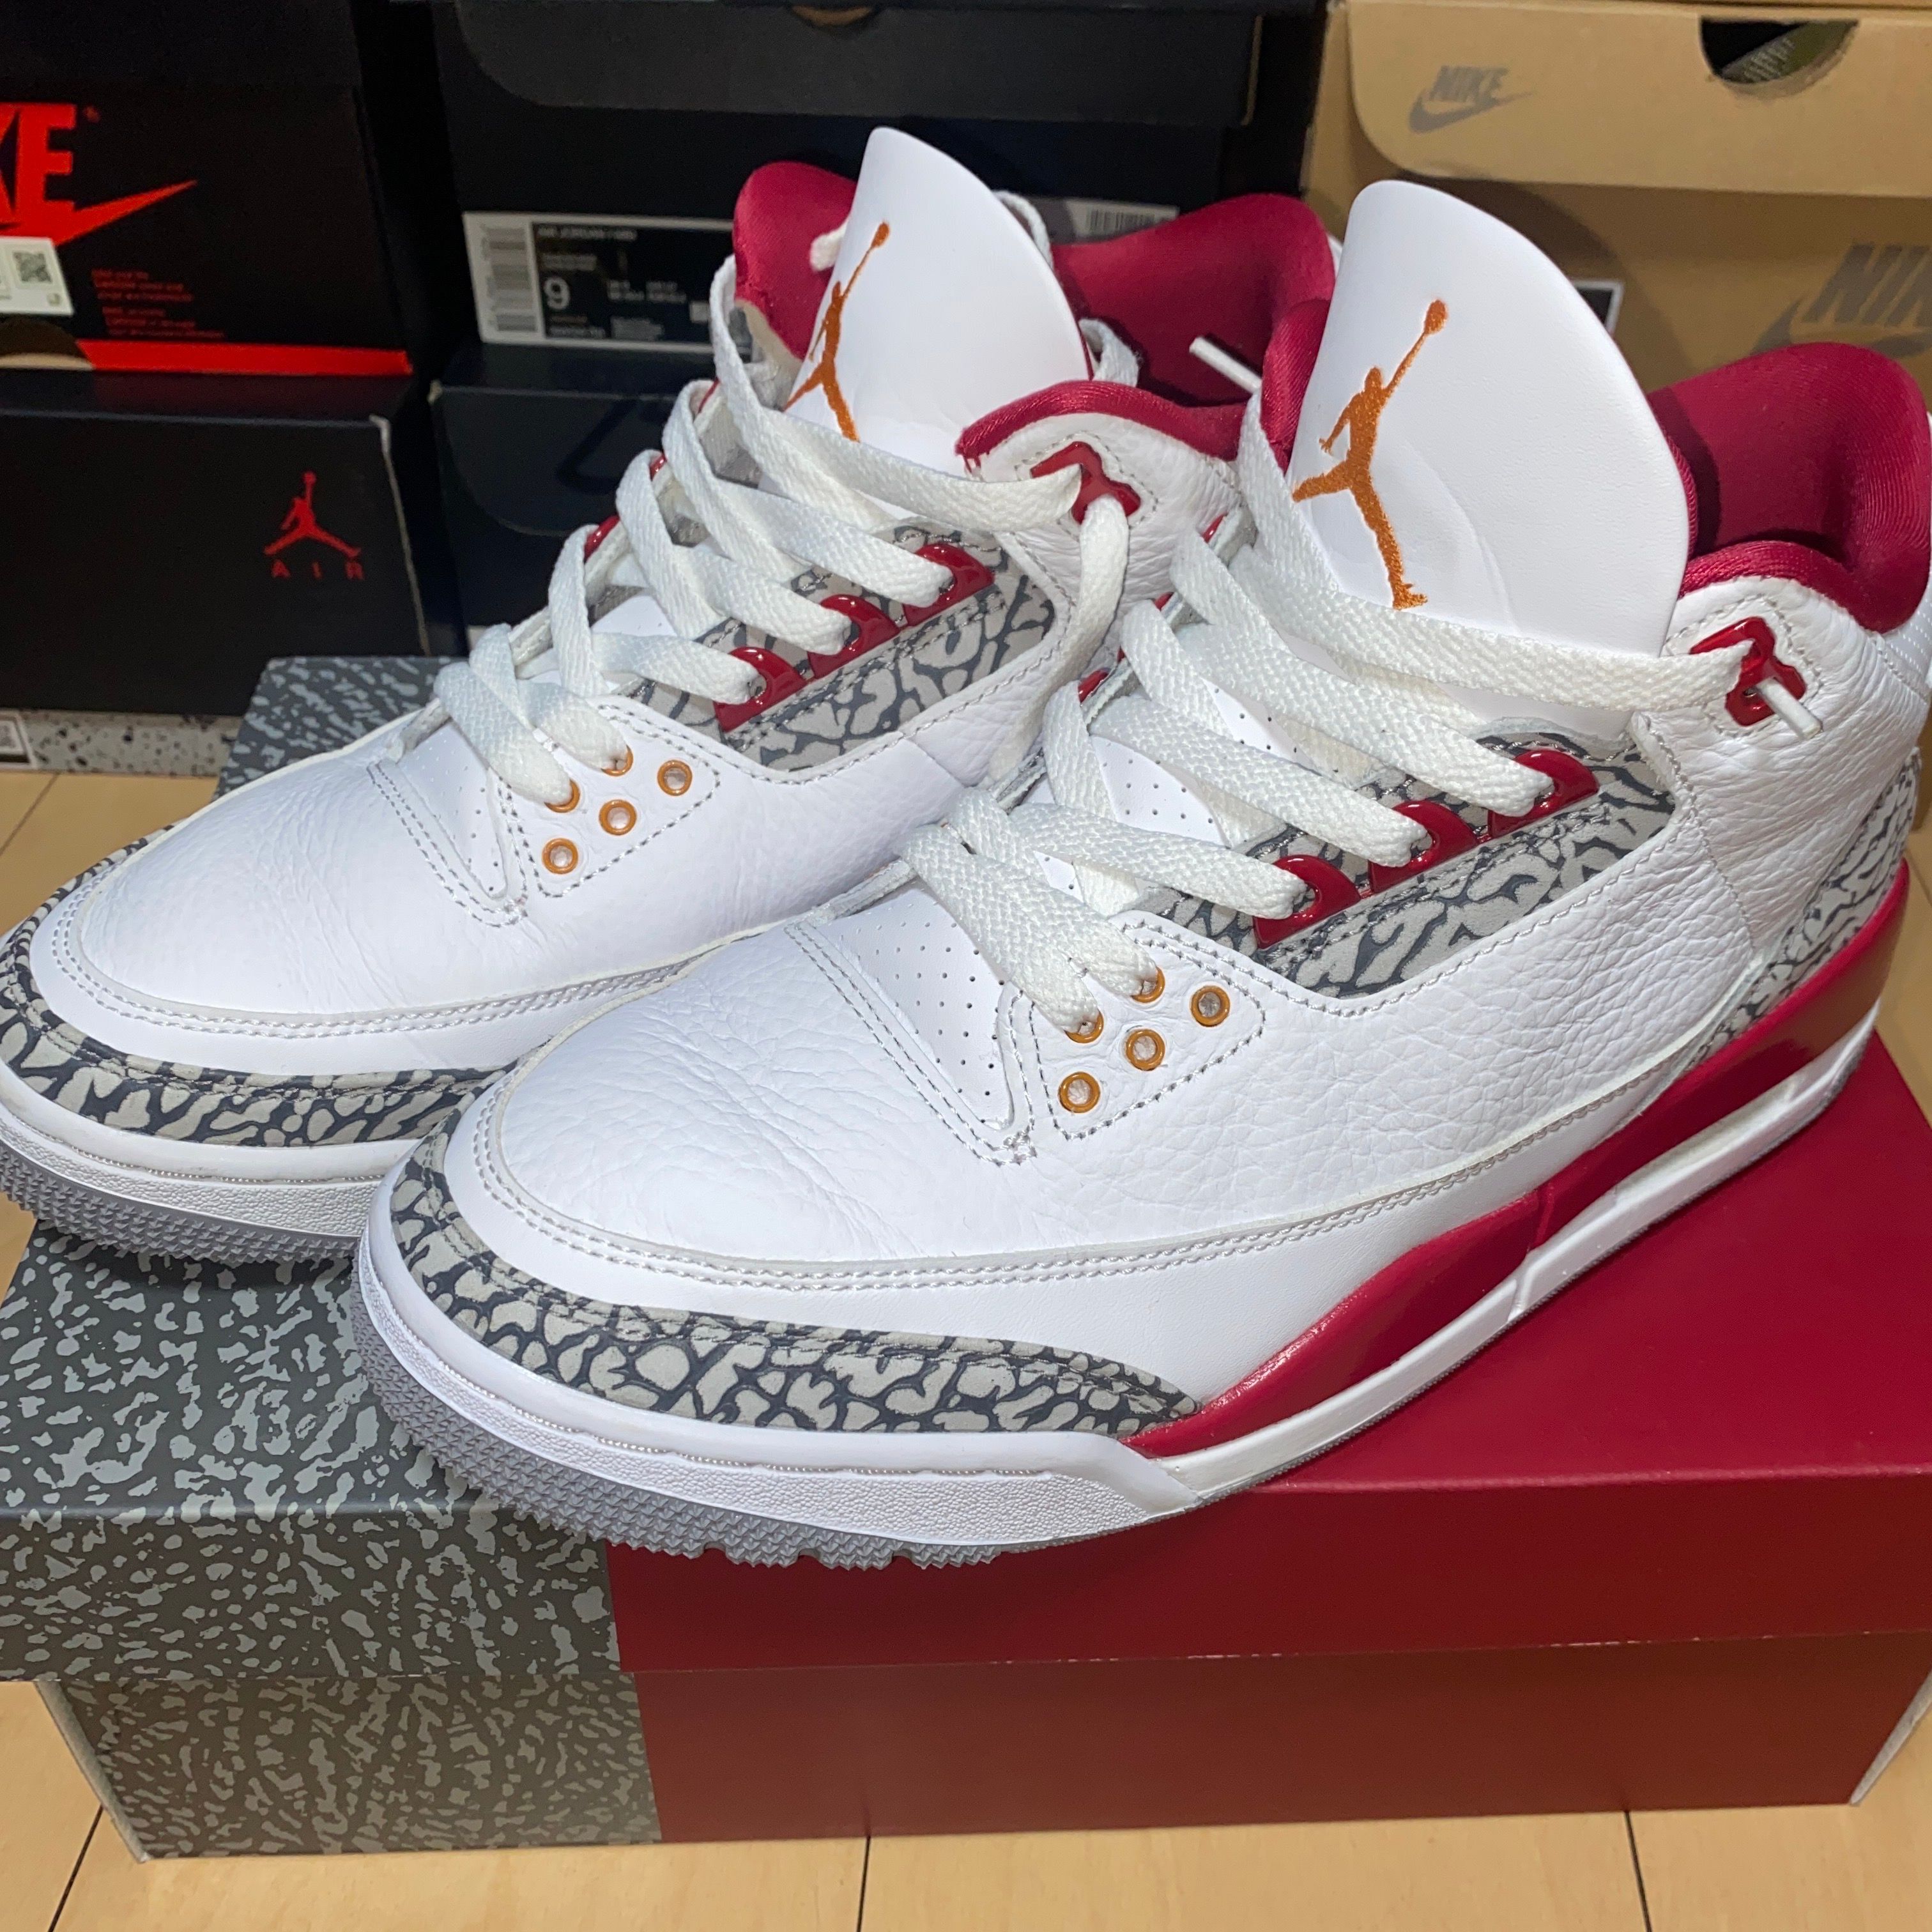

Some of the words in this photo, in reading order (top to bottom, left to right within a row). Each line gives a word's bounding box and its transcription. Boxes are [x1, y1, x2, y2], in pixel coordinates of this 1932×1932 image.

[1429, 65, 1508, 106] NIKE
[543, 276, 571, 310] 9
[272, 560, 364, 581] AIR
